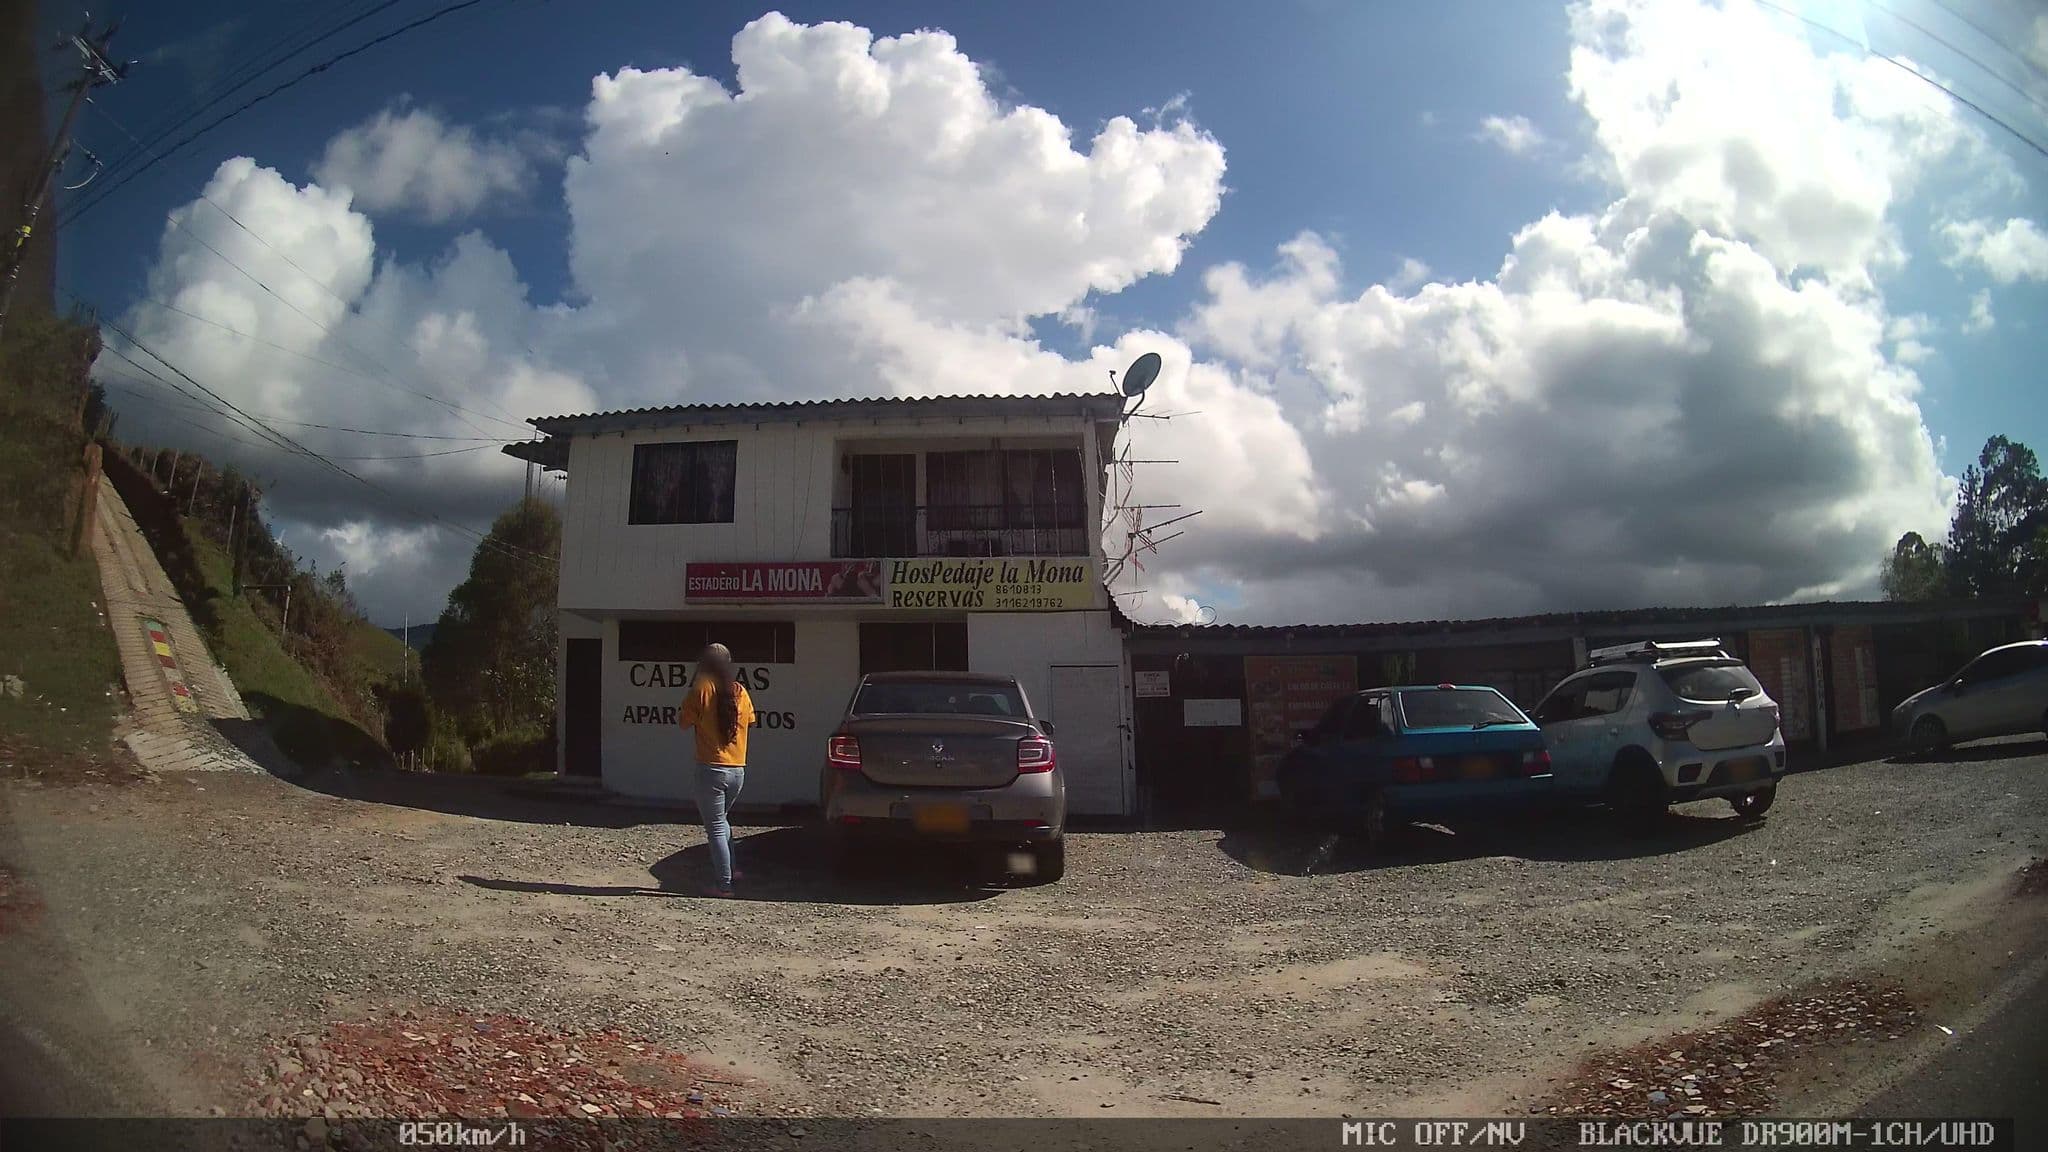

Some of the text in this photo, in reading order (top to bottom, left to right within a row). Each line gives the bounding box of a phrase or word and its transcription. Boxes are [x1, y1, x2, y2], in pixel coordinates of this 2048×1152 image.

[688, 568, 823, 592] ESTADERO LA MONA
[1000, 561, 1019, 583] la
[1024, 559, 1085, 583] Mona
[629, 663, 770, 691] CABAS
